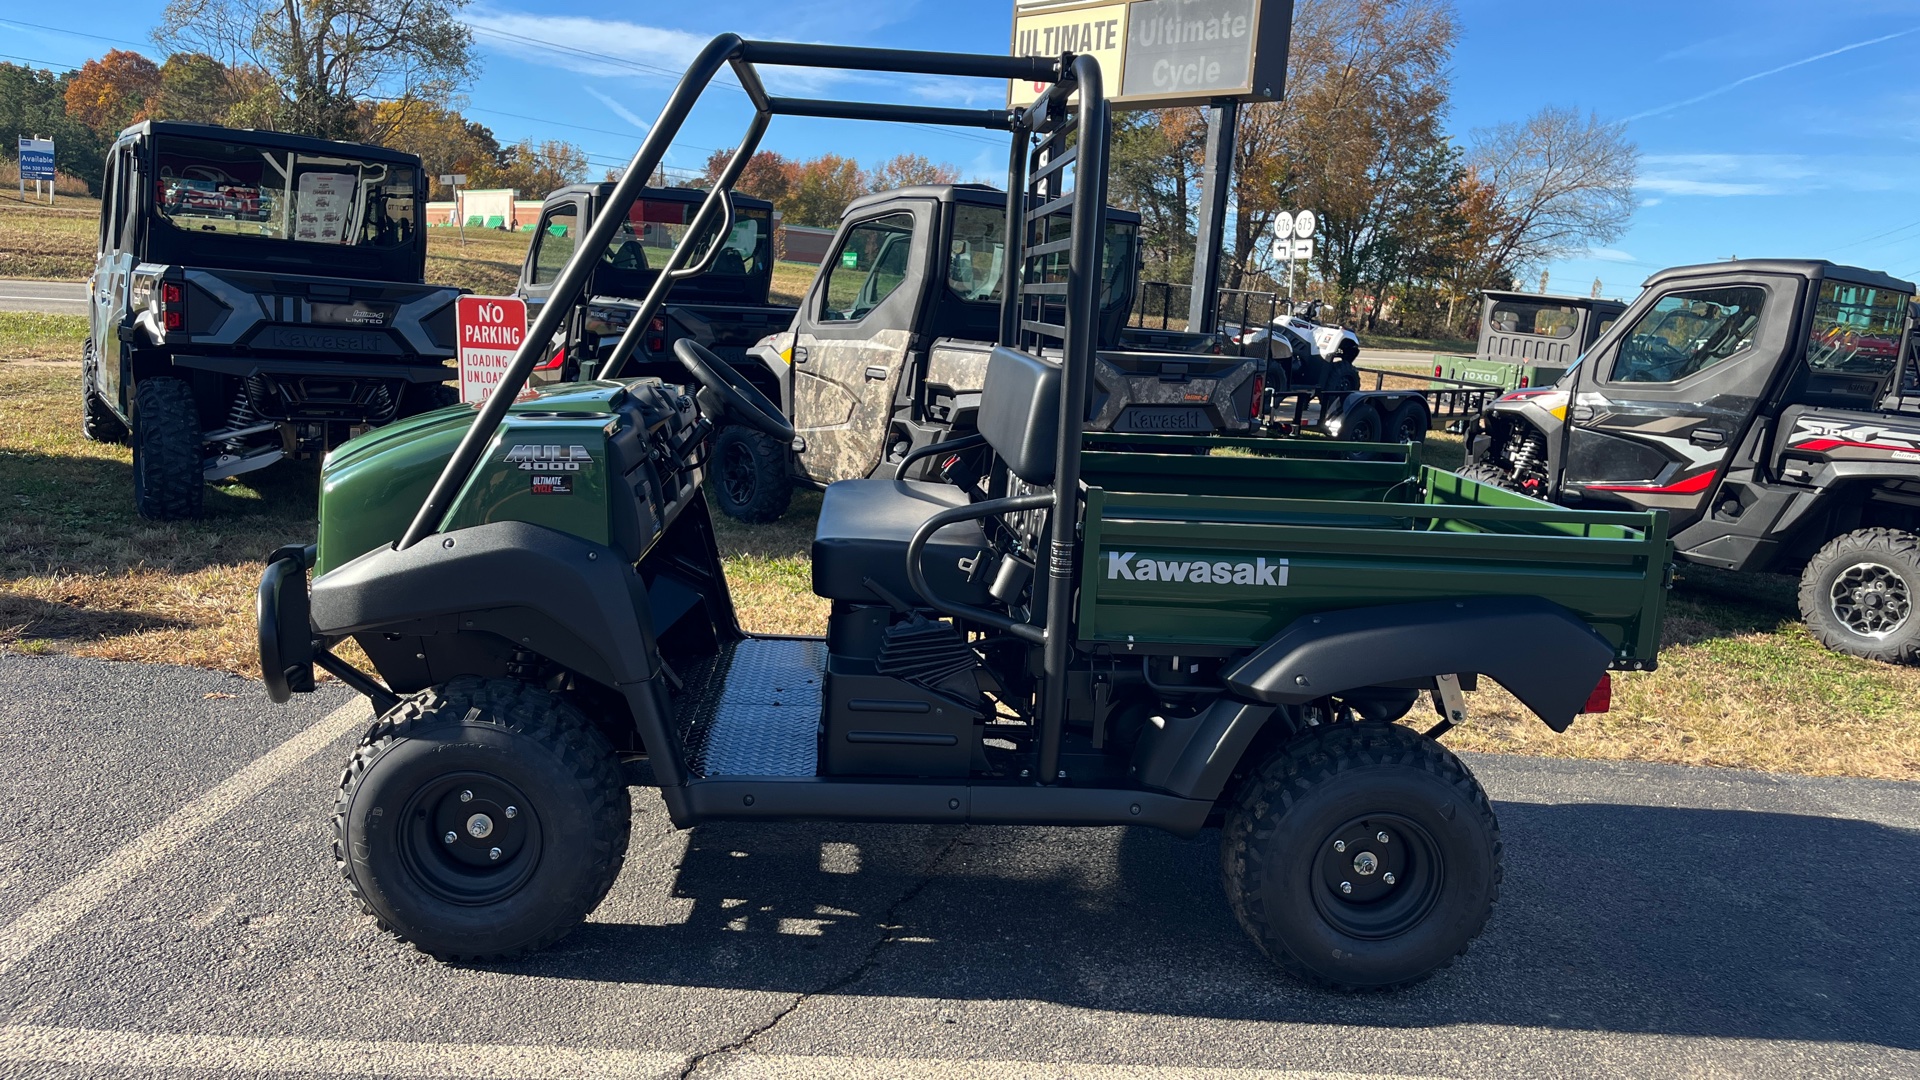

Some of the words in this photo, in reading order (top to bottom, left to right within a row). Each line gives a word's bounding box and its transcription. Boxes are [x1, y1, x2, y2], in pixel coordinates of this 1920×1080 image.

[1018, 19, 1118, 57] ULTIMATE
[1139, 11, 1247, 47] Ultimate
[1152, 56, 1222, 92] Cycle
[21, 154, 54, 164] Available
[1297, 217, 1312, 231] 675
[478, 304, 504, 324] NO
[273, 329, 381, 351] Kawasaki
[465, 325, 520, 345] PARKING
[467, 353, 508, 368] LOADING
[1129, 410, 1200, 429] Kawasaki
[1810, 426, 1865, 439] RIDGE
[503, 444, 594, 463] MULE
[517, 462, 580, 471] 4000
[533, 476, 563, 485] ULTIMATE
[1107, 551, 1290, 587] Kawasaki
